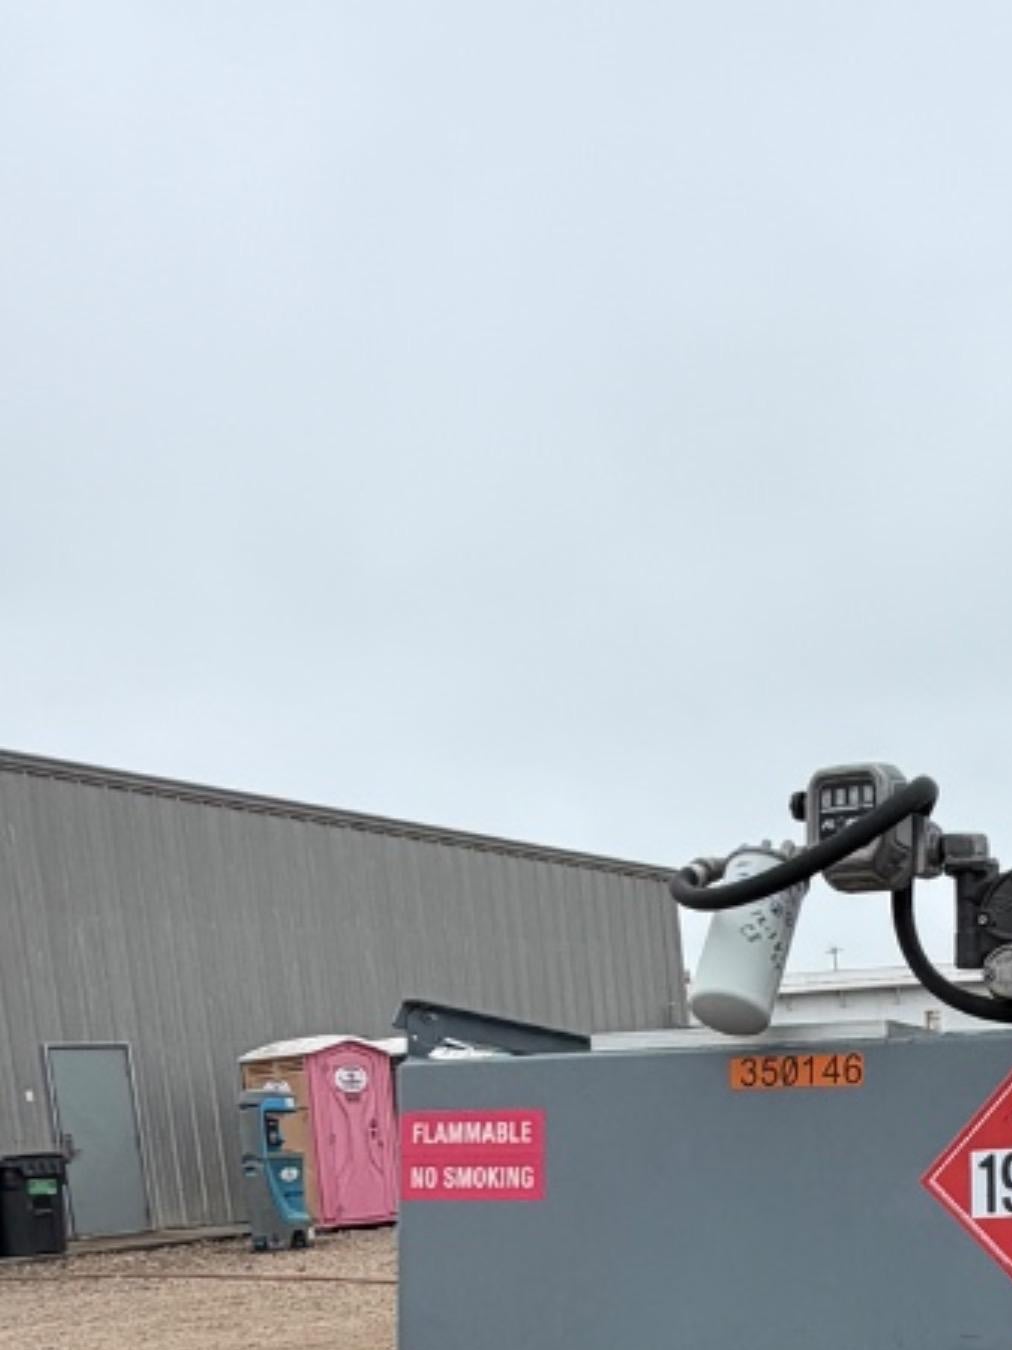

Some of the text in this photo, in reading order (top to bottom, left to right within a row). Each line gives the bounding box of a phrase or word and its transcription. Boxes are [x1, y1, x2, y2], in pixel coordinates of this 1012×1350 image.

[740, 1052, 862, 1087] 350146
[412, 1121, 533, 1144] FLAMMABLE
[410, 1166, 535, 1189] NO SMOKING
